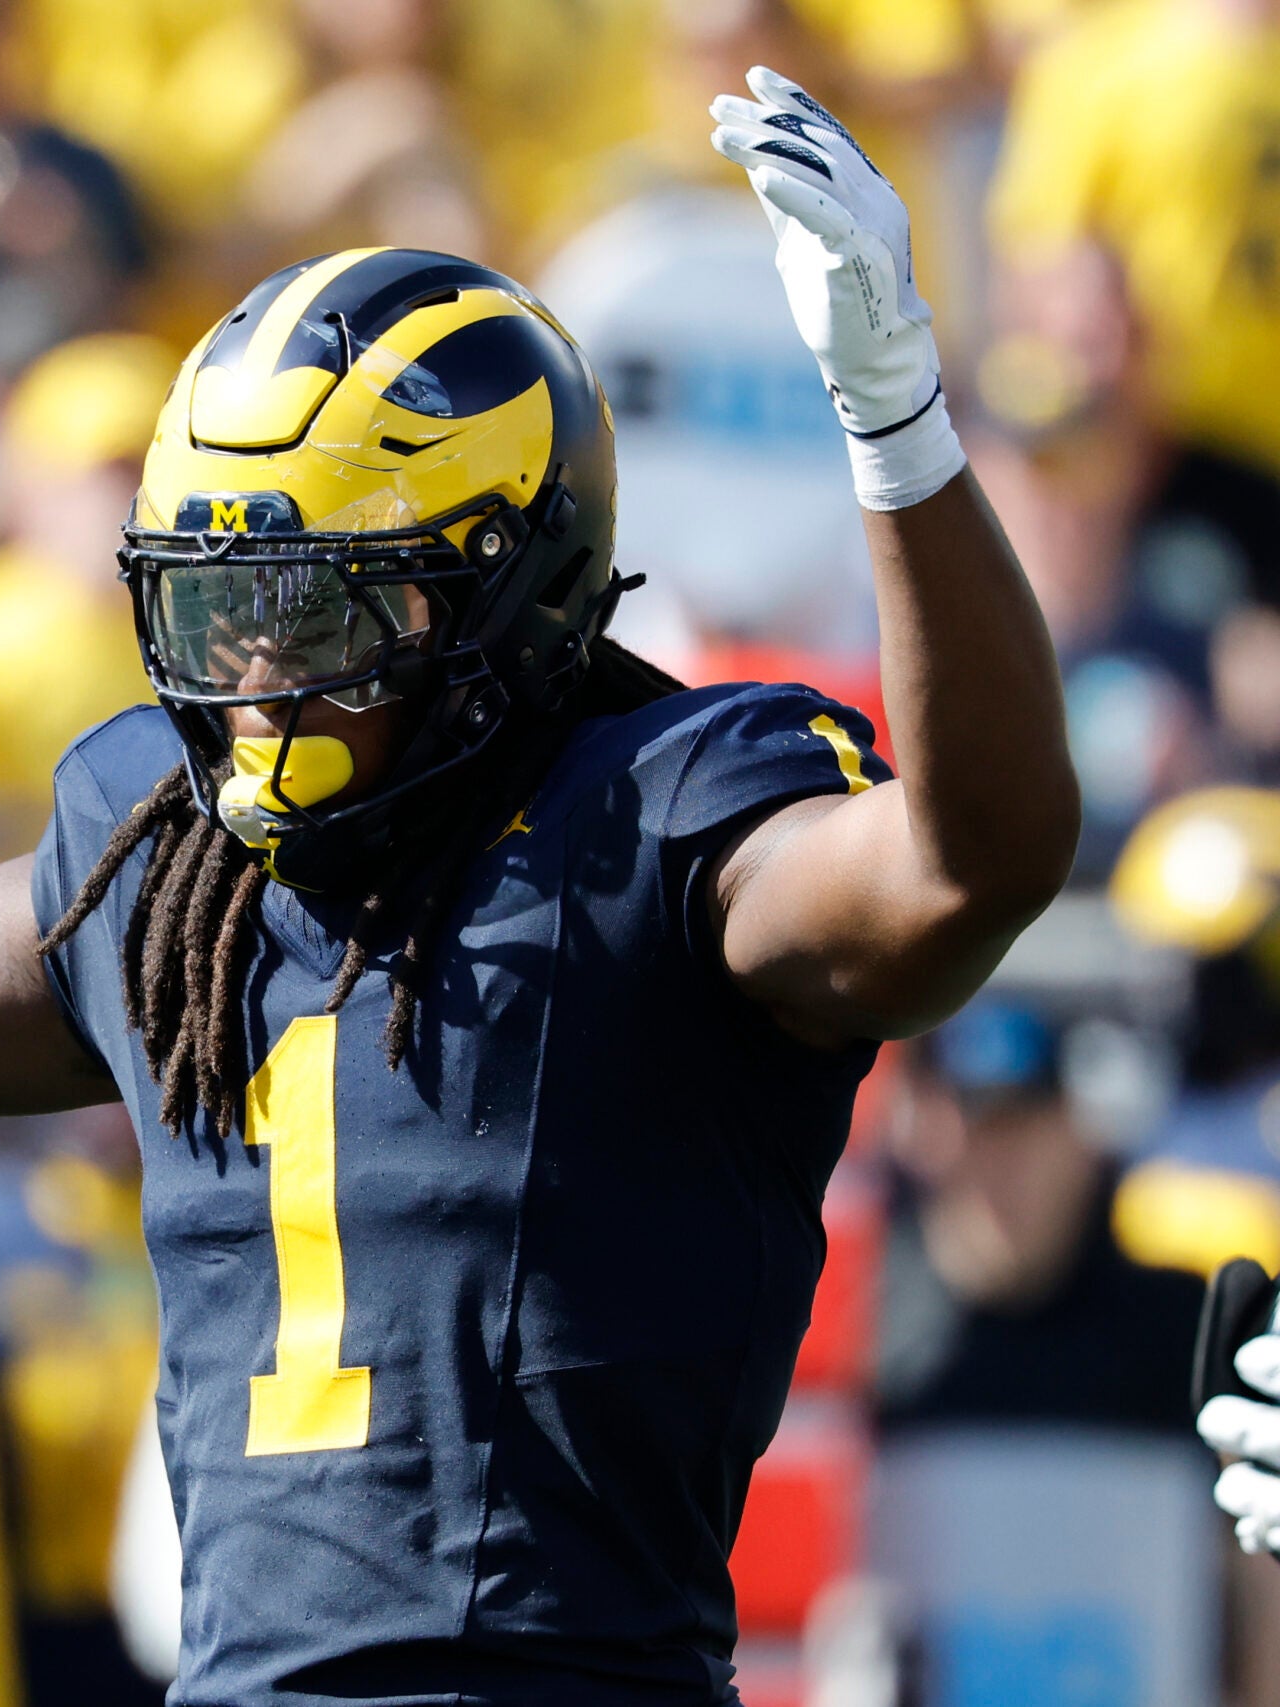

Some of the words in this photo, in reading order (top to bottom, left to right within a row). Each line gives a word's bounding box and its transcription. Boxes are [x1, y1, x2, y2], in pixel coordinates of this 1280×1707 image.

[210, 499, 248, 532] M
[807, 713, 874, 797] 1
[245, 1015, 371, 1457] 1
